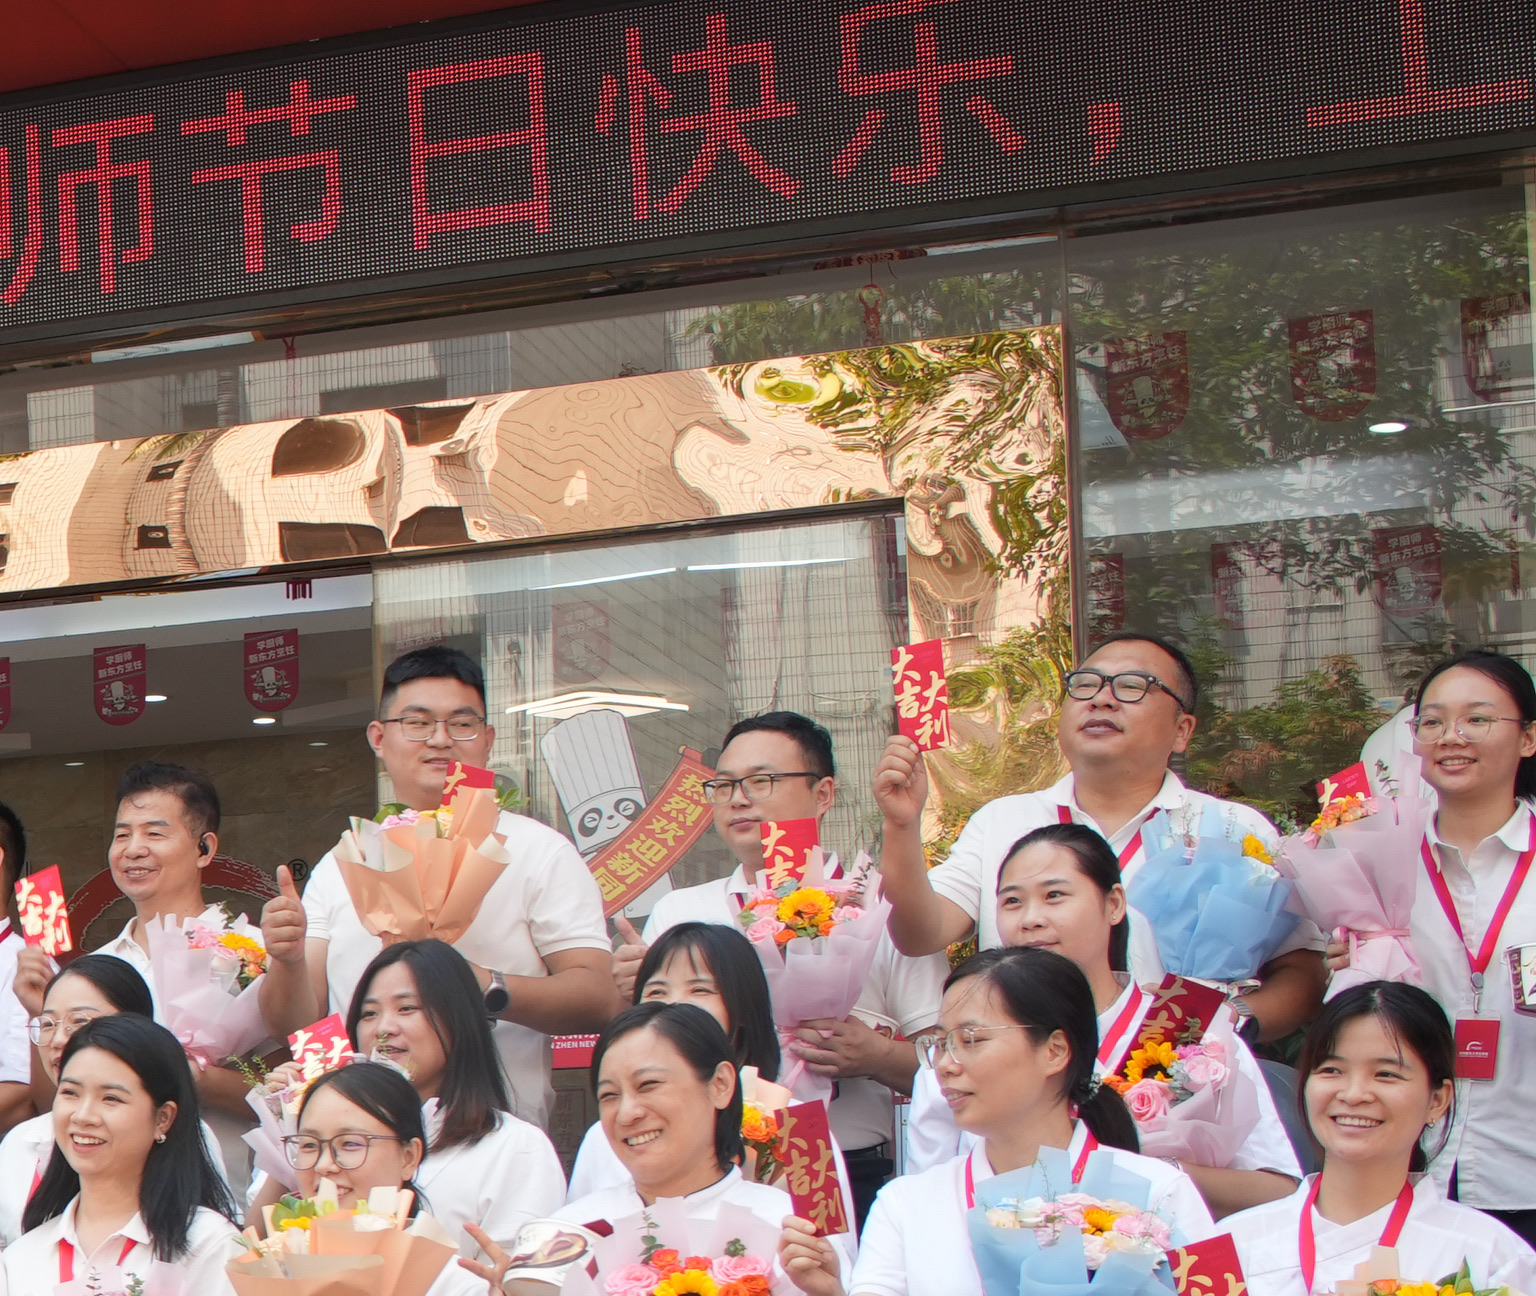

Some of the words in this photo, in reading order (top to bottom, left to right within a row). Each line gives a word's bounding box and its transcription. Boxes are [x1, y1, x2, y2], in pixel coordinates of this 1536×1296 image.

[593, 773, 708, 902] 热烈欢迎新同
[556, 1040, 579, 1049] ZHEN
